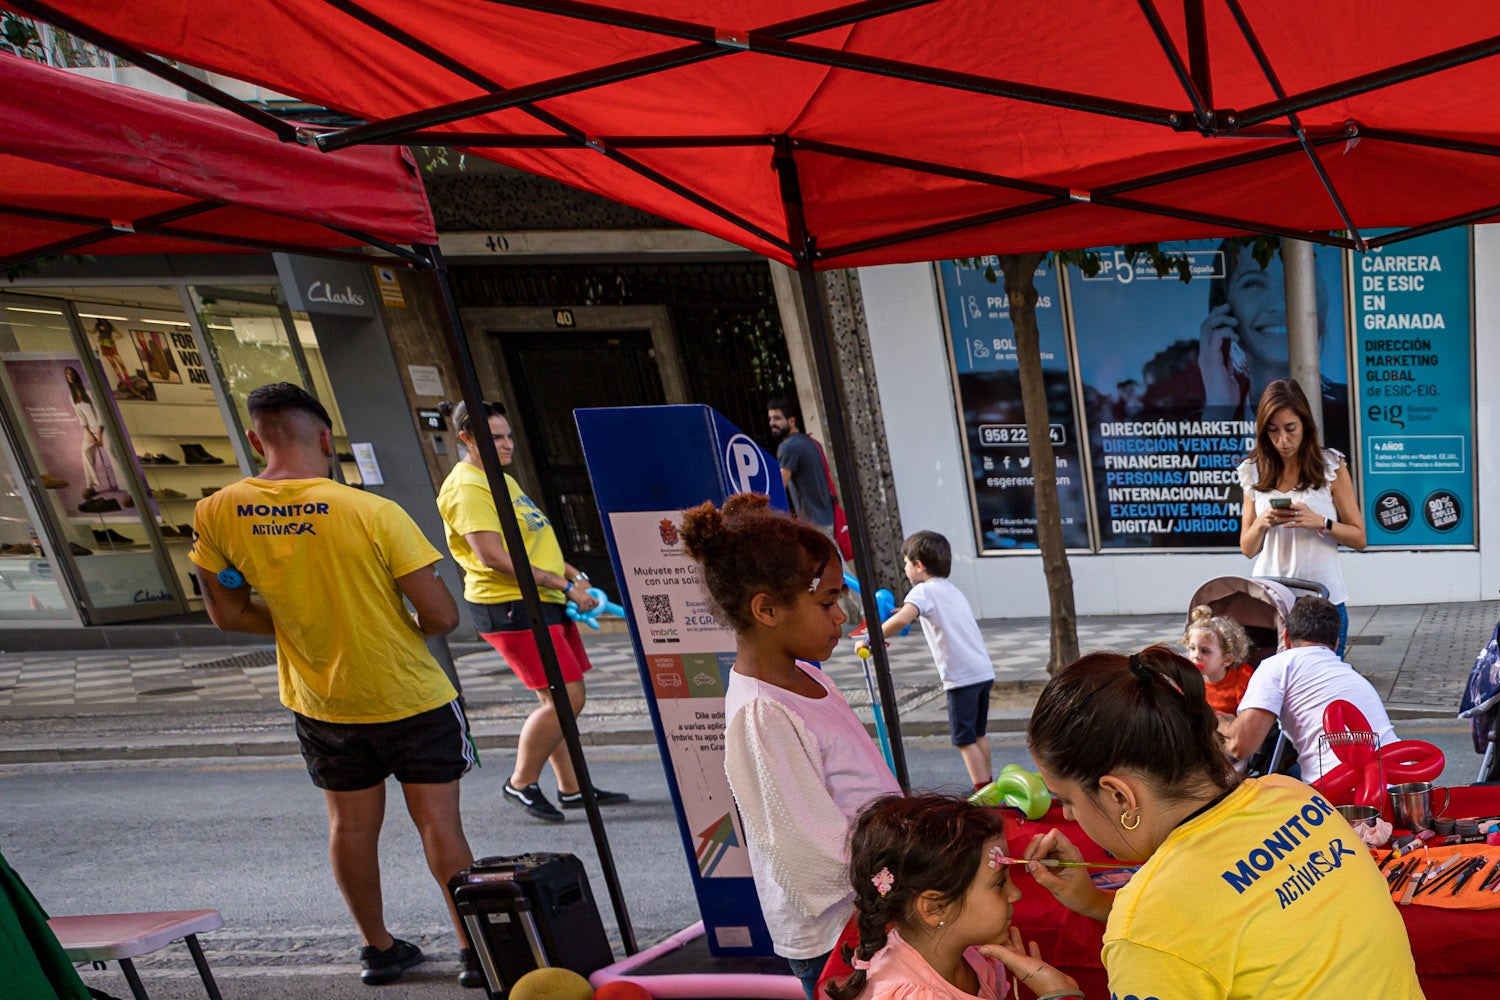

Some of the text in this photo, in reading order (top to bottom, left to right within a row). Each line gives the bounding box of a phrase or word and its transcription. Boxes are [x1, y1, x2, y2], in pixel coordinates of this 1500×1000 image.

[485, 235, 509, 252] 40
[1361, 256, 1441, 272] CARRERA
[1362, 275, 1424, 291] DE ESIC
[307, 281, 365, 306] Clarks
[1363, 295, 1385, 310] EN
[556, 312, 574, 327] 40
[1364, 313, 1445, 330] GRANADA
[170, 332, 196, 349] FOR
[1365, 336, 1431, 352] DIRECCIÓN
[1365, 355, 1438, 366] MARKETING
[1366, 370, 1416, 381] GLOBAL
[1367, 385, 1382, 396] de
[1368, 404, 1405, 430] eig
[984, 428, 1009, 442] 958
[1100, 418, 1177, 437] DIRECCIÓN
[1102, 436, 1179, 452] DIRECCIÓN
[732, 443, 760, 494] P
[1108, 486, 1231, 501] INTERNACIONAL/
[237, 503, 329, 517] MONITOR
[1110, 503, 1189, 517] EXECUTIVE
[633, 565, 672, 576] Muévete
[674, 567, 686, 575] en
[694, 711, 710, 720] Dile
[1221, 795, 1335, 895] MONITOR
